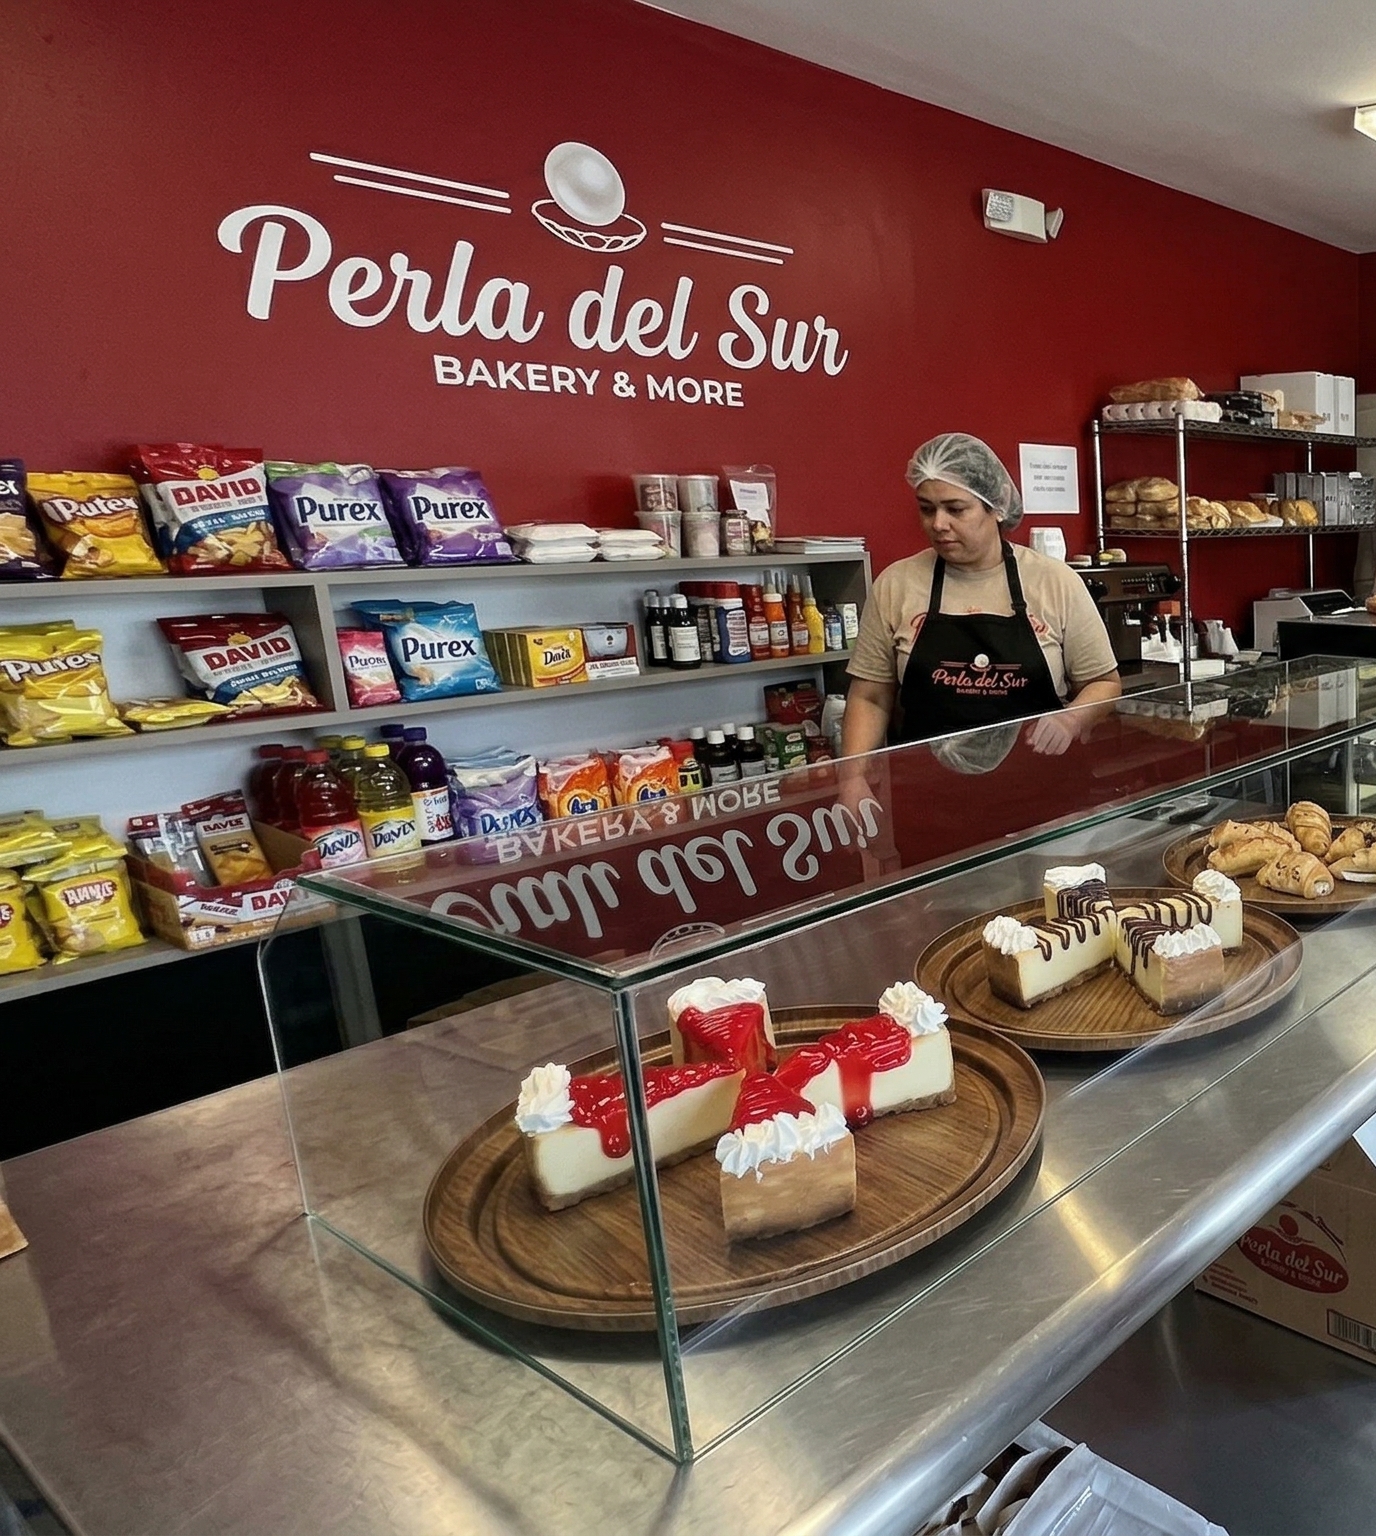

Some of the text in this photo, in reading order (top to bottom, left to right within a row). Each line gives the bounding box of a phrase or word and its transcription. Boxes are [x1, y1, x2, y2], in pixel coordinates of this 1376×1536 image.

[217, 204, 850, 376] Perla del Sur
[433, 354, 745, 407] BAKERY & MORE
[170, 477, 262, 506] DAVID
[296, 497, 382, 523] Purex
[411, 496, 490, 523] Purex
[202, 637, 292, 671] DAVID
[402, 637, 477, 662] Purex
[931, 668, 1029, 689] Perla del Sur
[1285, 1250, 1311, 1273] del
[1312, 1260, 1343, 1285] Sur
